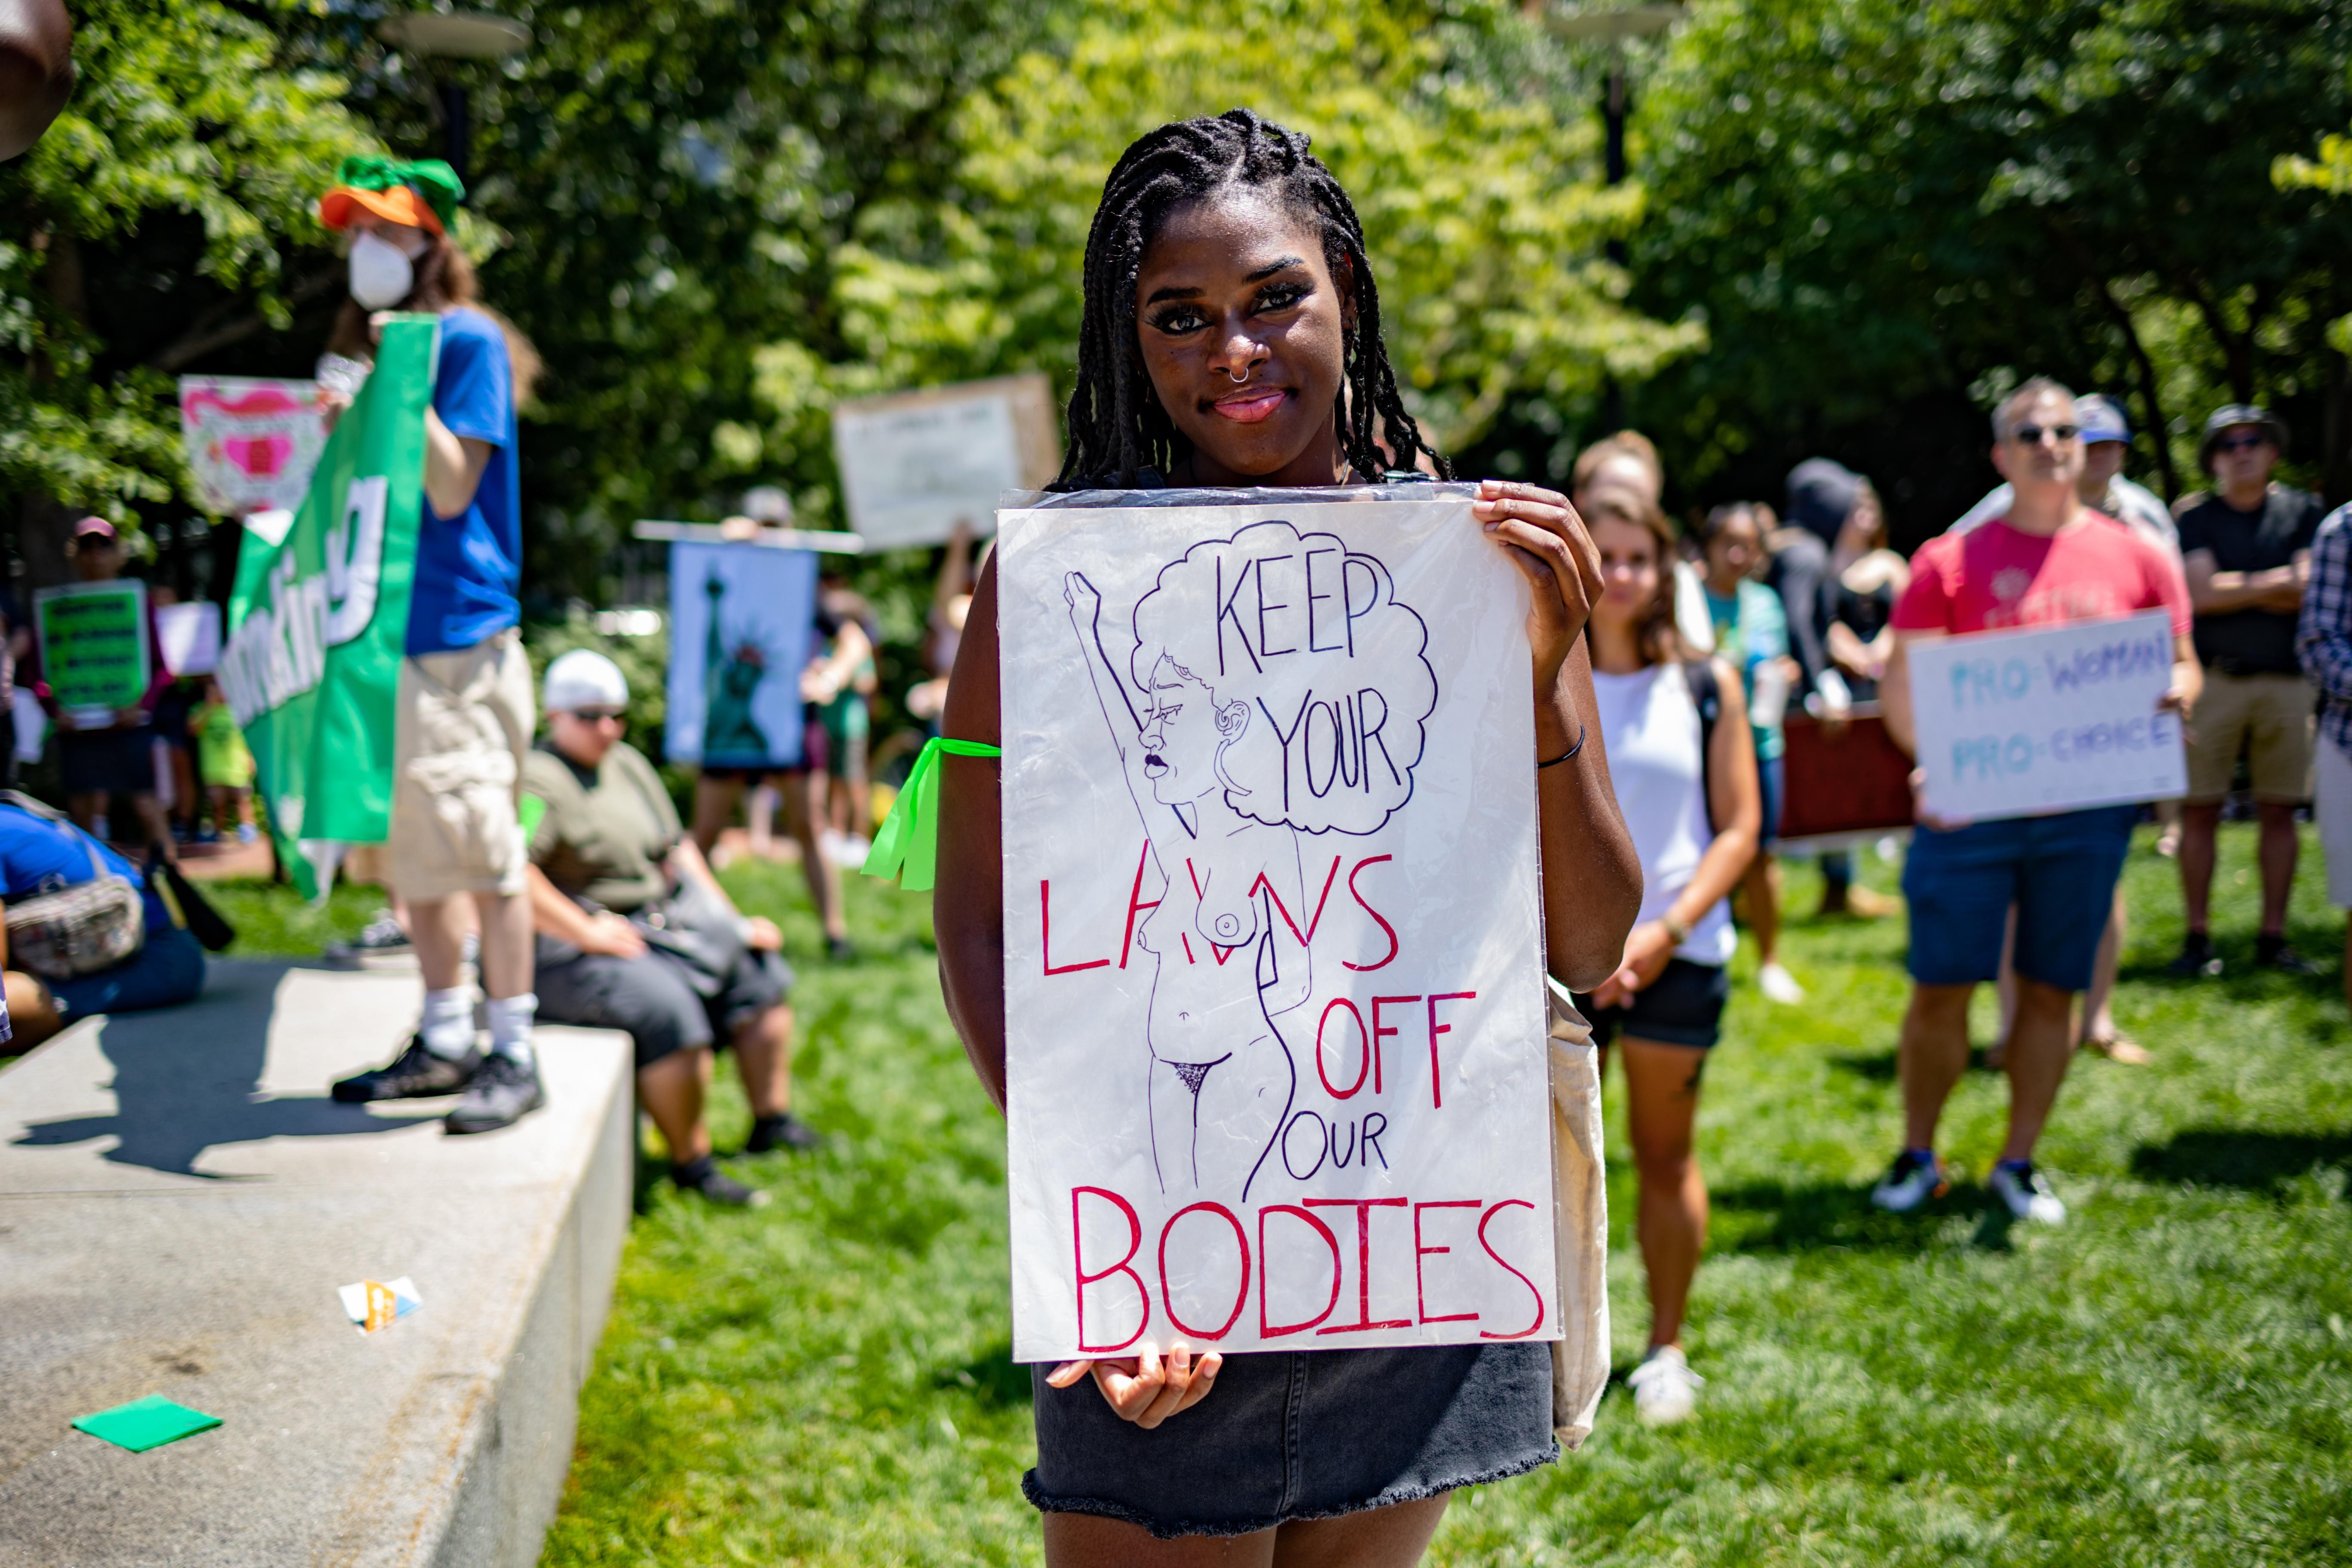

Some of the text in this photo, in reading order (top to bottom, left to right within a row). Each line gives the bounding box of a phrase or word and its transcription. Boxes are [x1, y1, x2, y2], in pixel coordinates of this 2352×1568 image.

[1216, 547, 1378, 677] KEEP
[1256, 688, 1402, 814] YOUR
[1040, 838, 1400, 977] LAWS
[1315, 990, 1477, 1110] OFF
[1282, 1110, 1389, 1181] OUR
[1071, 1185, 1546, 1354] BODIES
